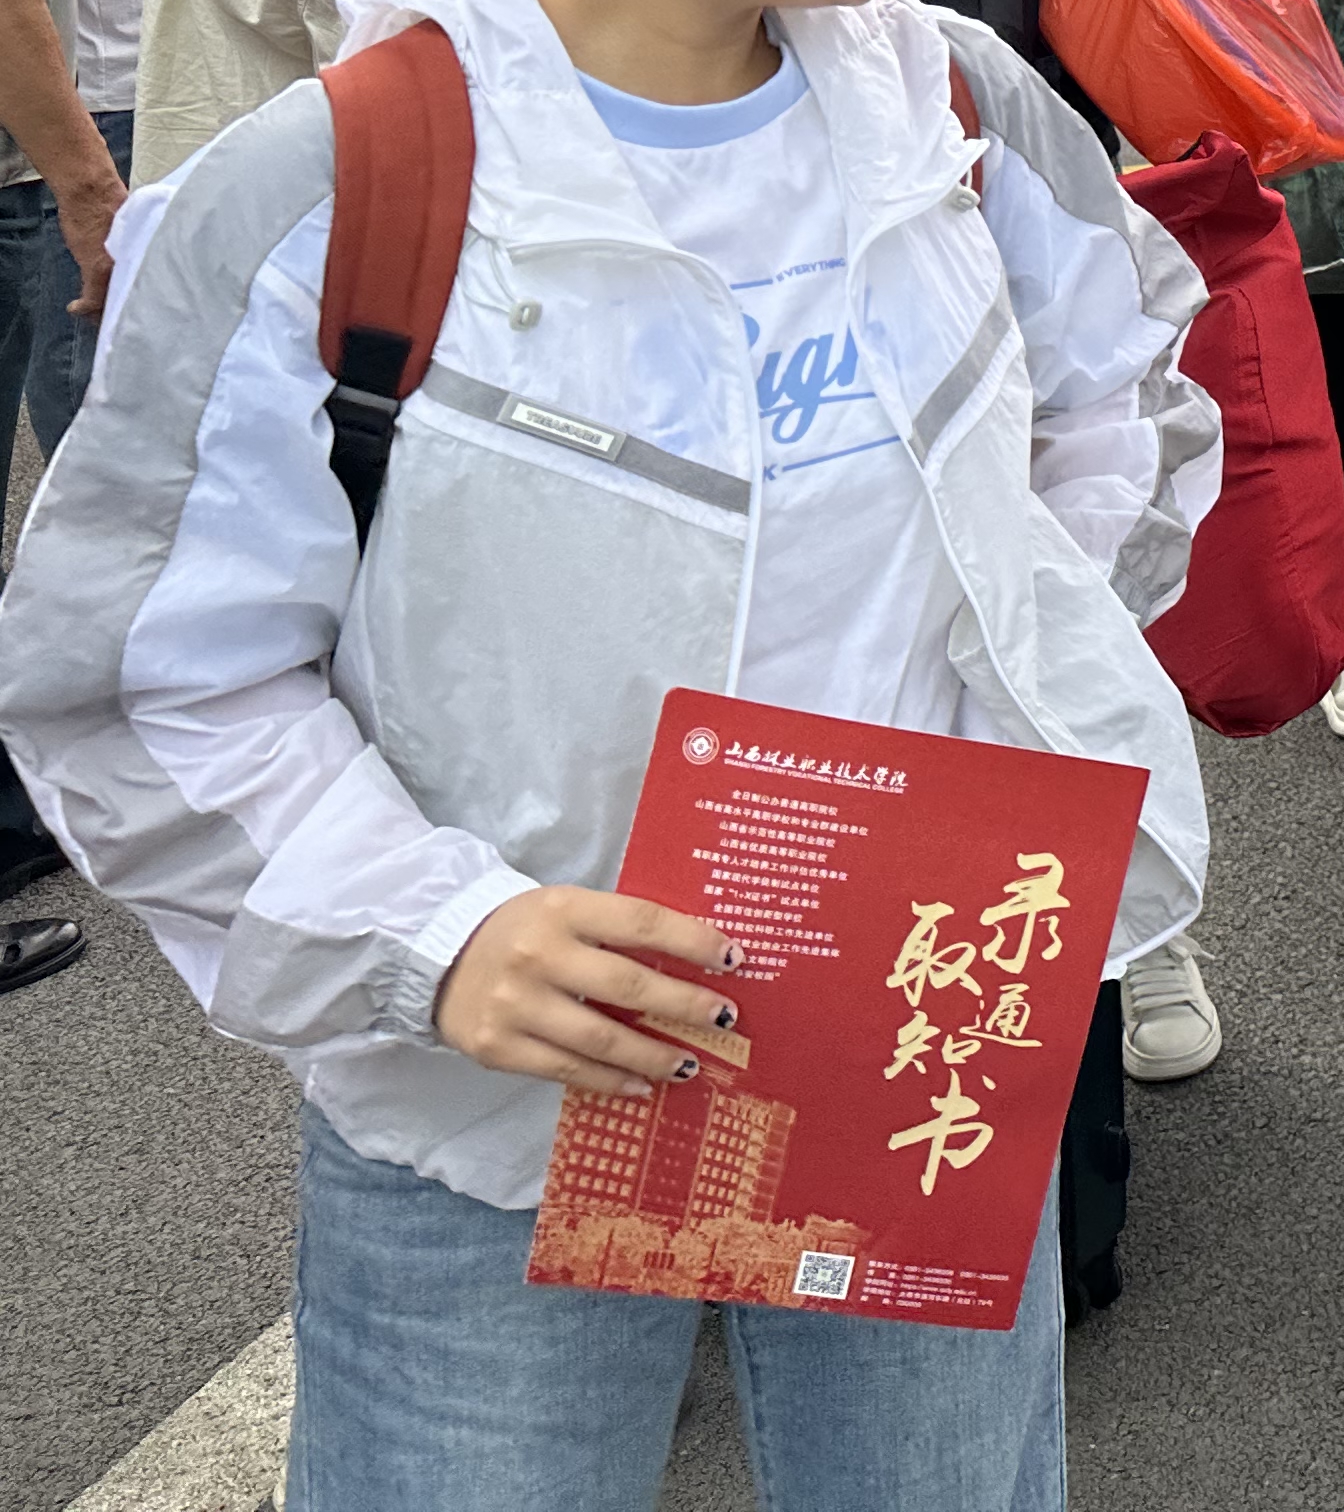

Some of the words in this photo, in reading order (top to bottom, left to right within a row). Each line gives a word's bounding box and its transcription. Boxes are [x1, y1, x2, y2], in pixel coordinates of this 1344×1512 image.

[884, 852, 1071, 1196] 录取通知书
